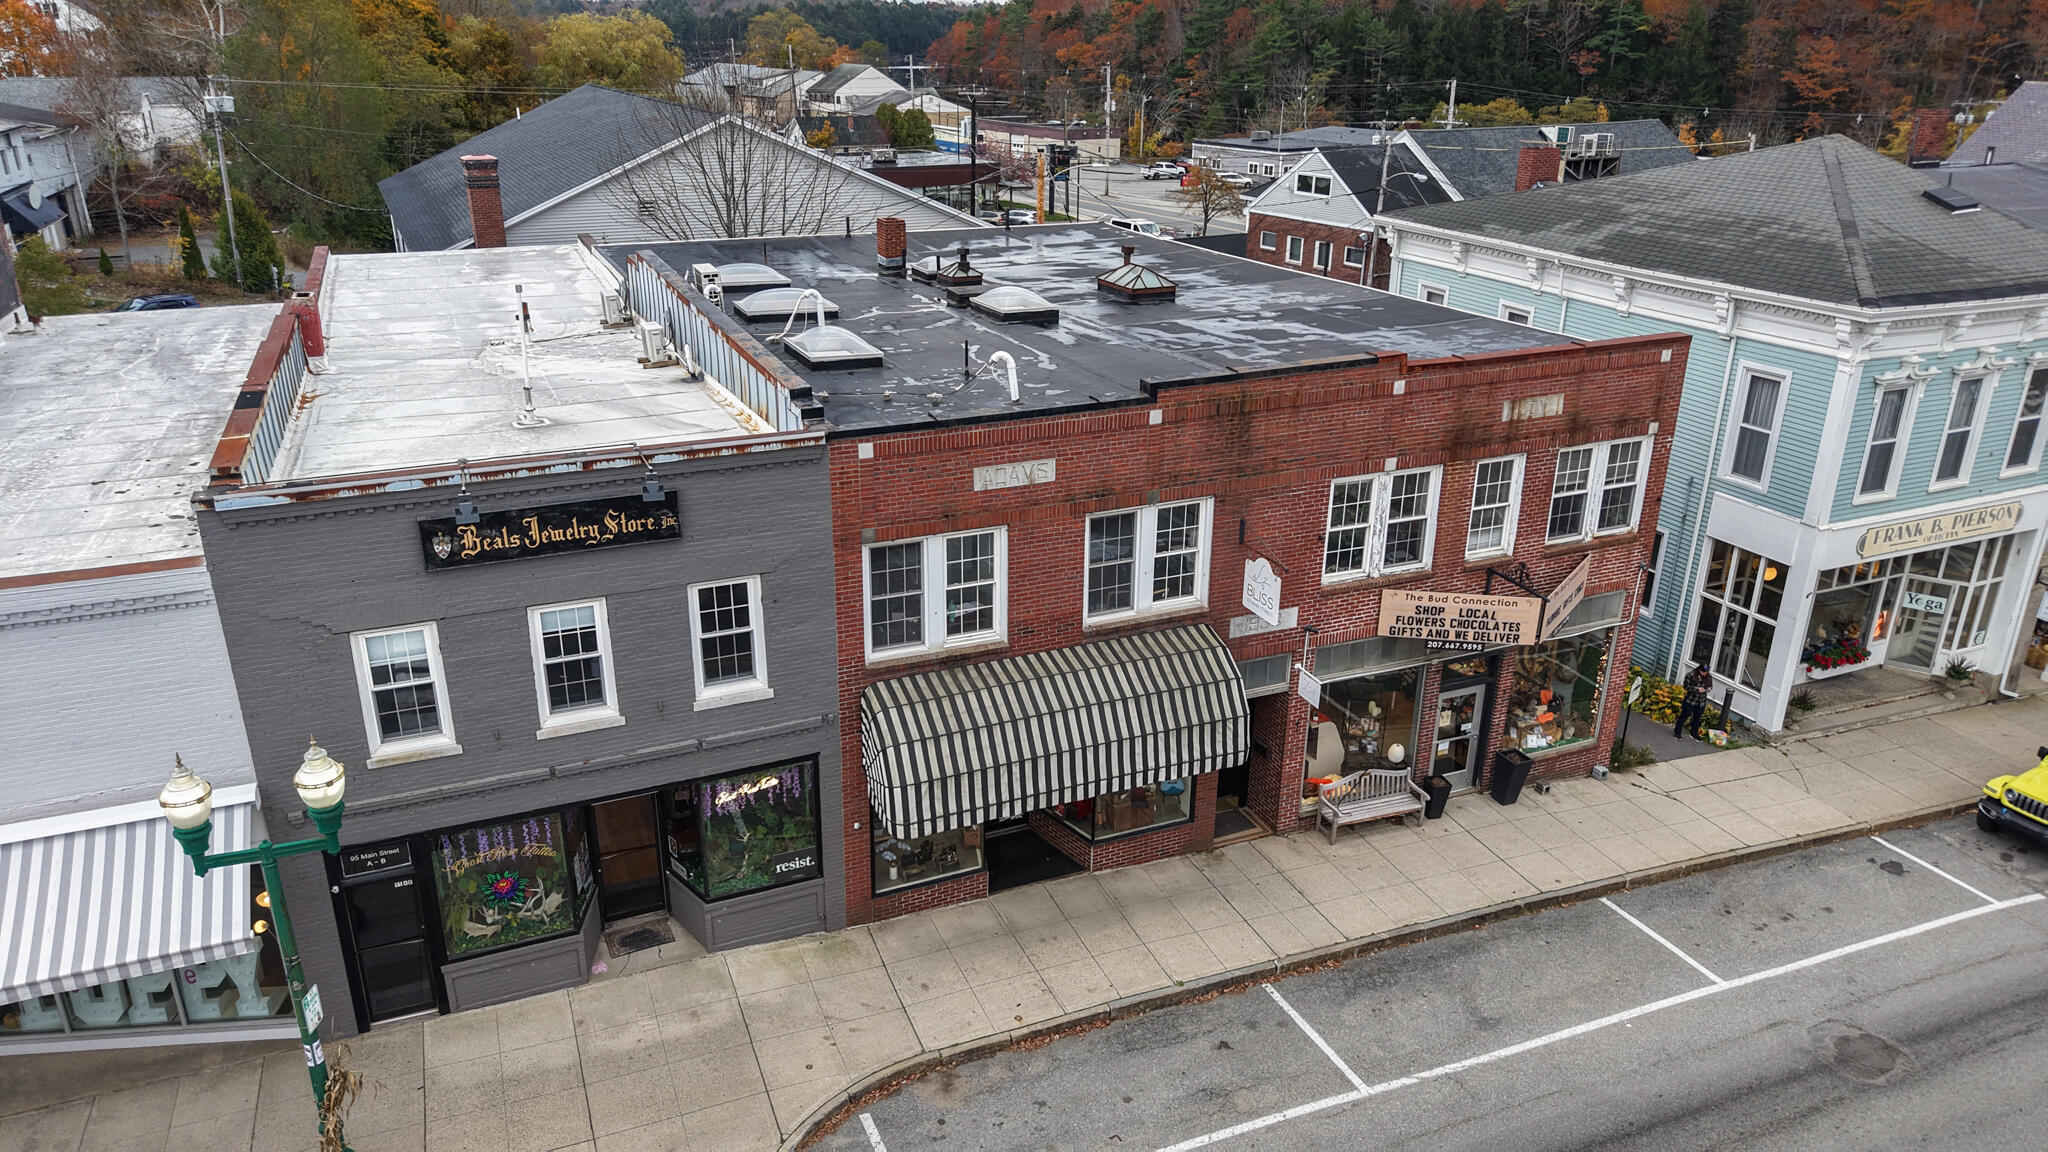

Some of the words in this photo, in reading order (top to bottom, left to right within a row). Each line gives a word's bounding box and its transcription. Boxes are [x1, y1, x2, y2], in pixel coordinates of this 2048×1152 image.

[1873, 522, 1923, 545] FRANK
[1931, 518, 1947, 534] B.
[1951, 506, 2013, 530] PIERSON
[457, 524, 520, 559] Beals
[522, 516, 600, 548] Jewelry
[1246, 583, 1274, 610] BLISS
[1405, 593, 1423, 602] The
[1428, 595, 1449, 604] Bud
[1453, 596, 1518, 608] Connection
[1415, 605, 1446, 616] SHOP
[1459, 607, 1498, 620] LOCAL
[1395, 615, 1446, 628] FLOWERS
[1450, 618, 1521, 632] CHOCOLATES
[1389, 625, 1423, 638] GIFTS
[1426, 628, 1450, 640] AND
[1455, 630, 1469, 641] WE
[1473, 631, 1520, 644] DELIVER
[1427, 641, 1483, 651] 207.667.9595
[360, 852, 378, 860] Main
[379, 847, 400, 857] Street
[775, 855, 815, 874] resist.
